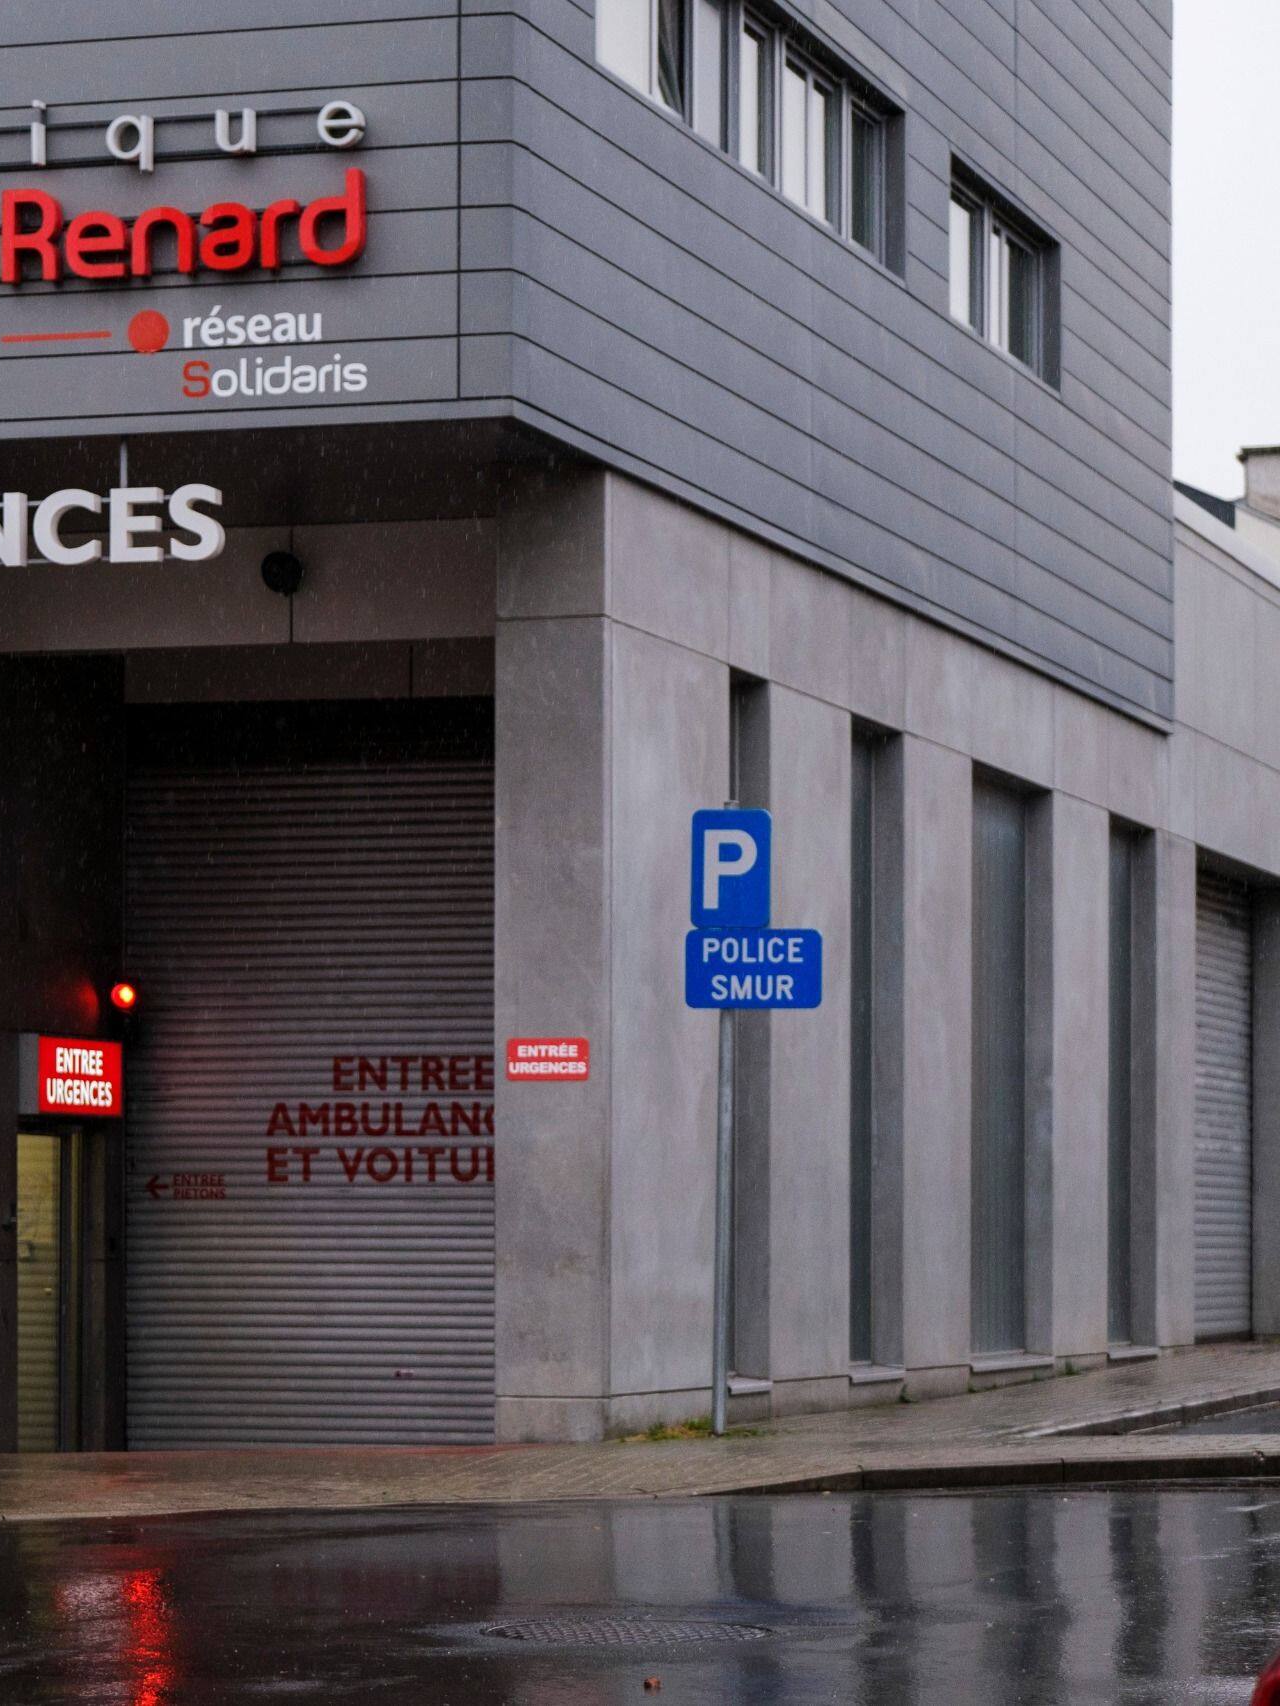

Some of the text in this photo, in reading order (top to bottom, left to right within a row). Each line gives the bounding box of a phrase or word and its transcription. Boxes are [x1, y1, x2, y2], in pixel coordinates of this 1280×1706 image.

[0, 167, 367, 284] Renard
[183, 305, 322, 348] réseau
[182, 353, 368, 398] Solidaris
[702, 829, 757, 909] P
[702, 937, 804, 963] POLICE
[711, 974, 794, 1000] SMUR
[55, 1046, 104, 1077] ENTREE
[517, 1042, 578, 1057] ENTRÉE
[332, 1055, 494, 1091] ENTREE
[508, 1061, 587, 1074] URGENCES
[46, 1077, 113, 1107] URGENCES
[266, 1147, 320, 1182] ET
